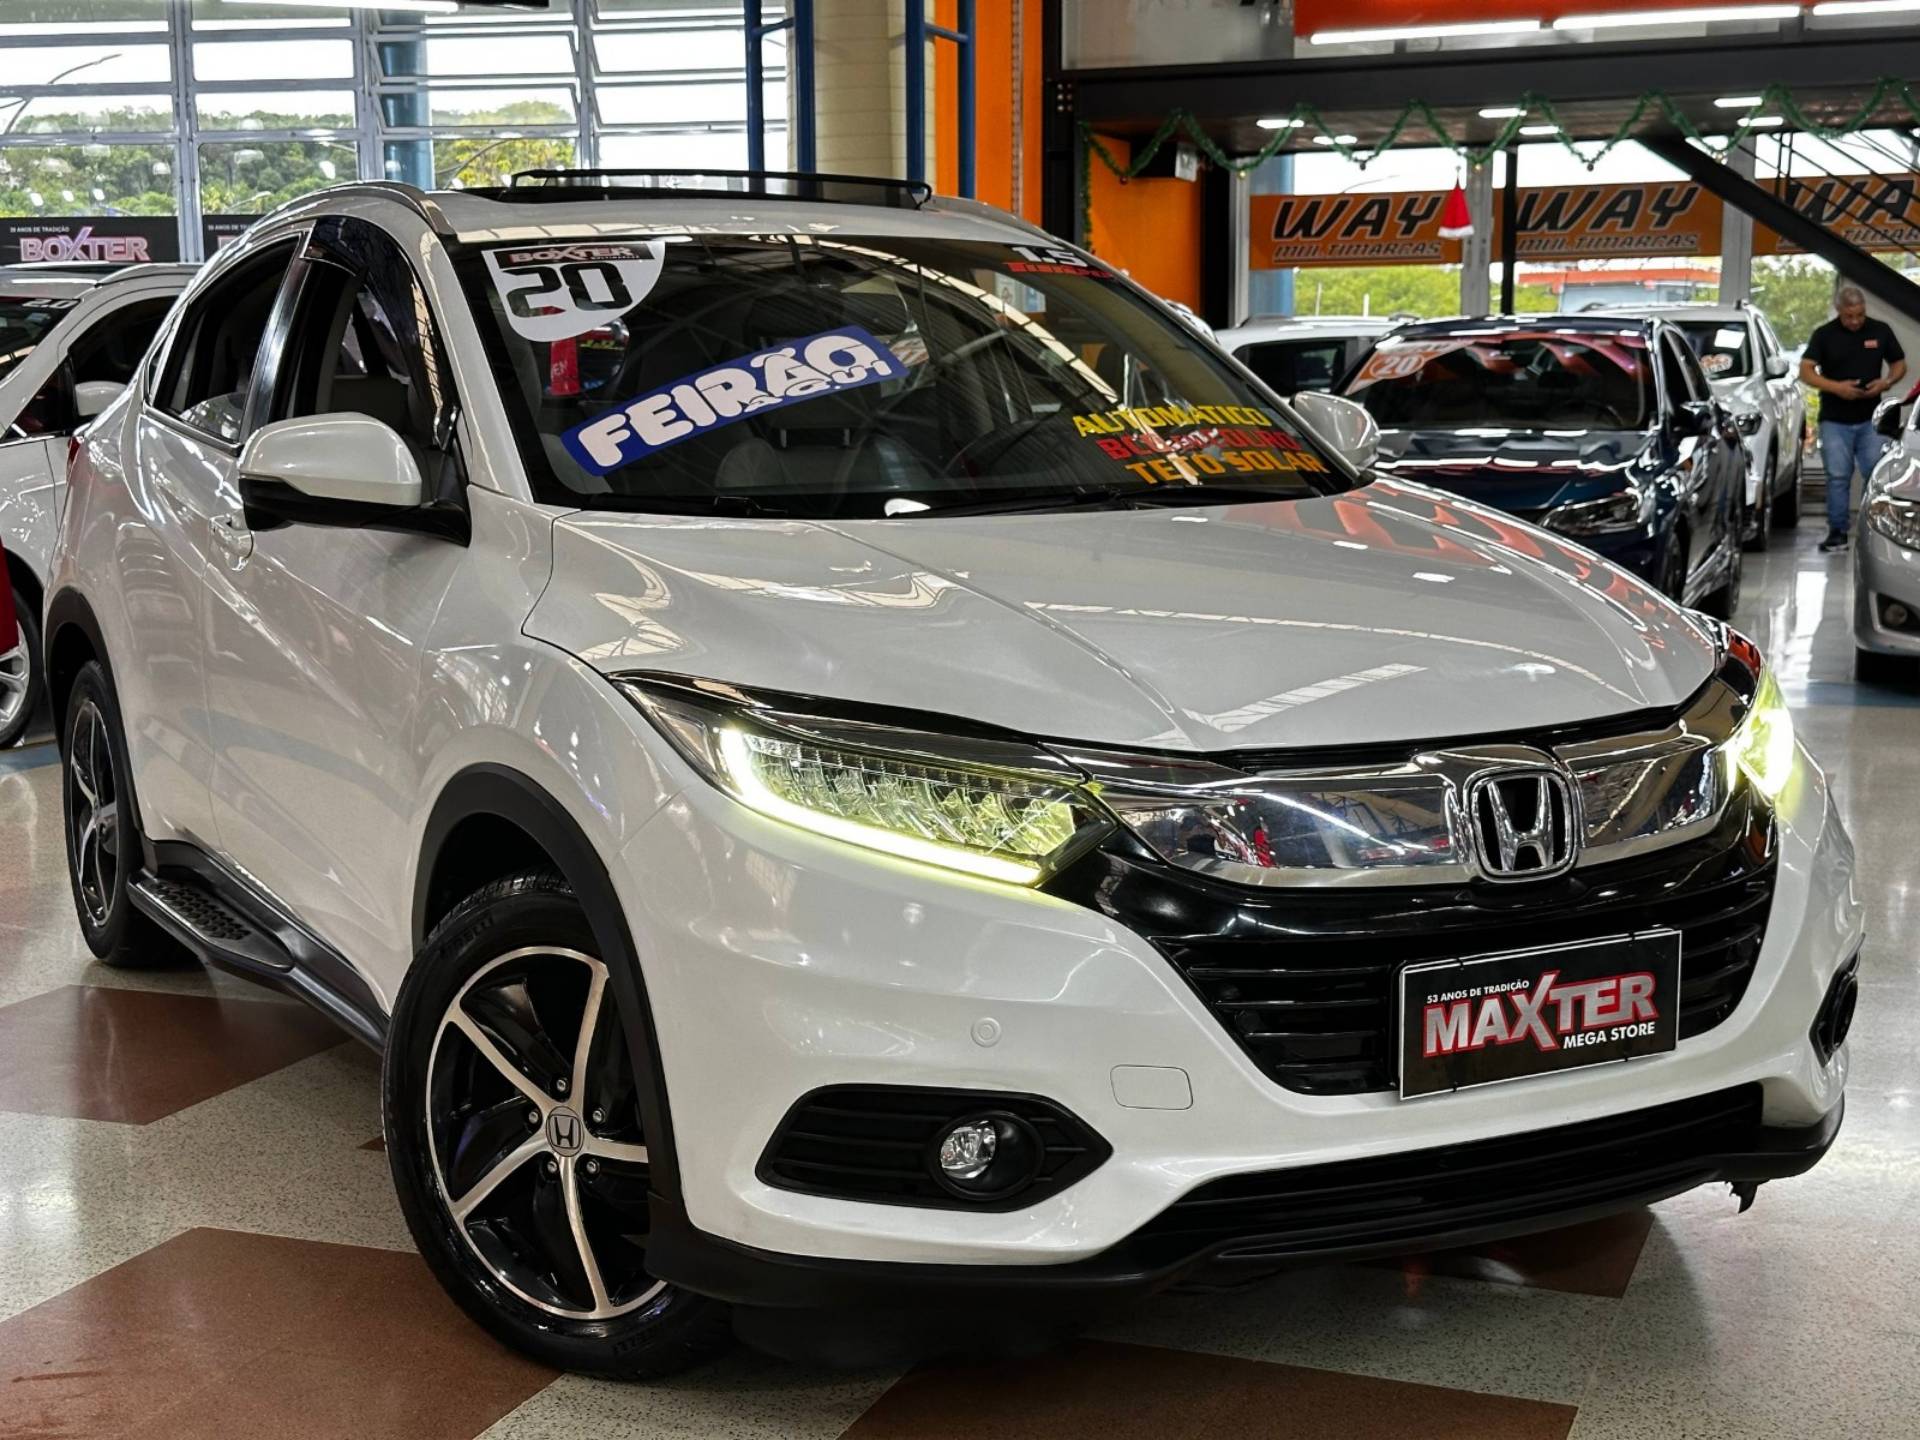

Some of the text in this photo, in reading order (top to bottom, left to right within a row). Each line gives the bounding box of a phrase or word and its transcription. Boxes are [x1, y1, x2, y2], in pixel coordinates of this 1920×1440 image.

[1273, 195, 1445, 240] WAY
[1516, 184, 1699, 233] WAY
[20, 226, 150, 262] BOXTER
[508, 245, 634, 263] BOXTER
[1011, 246, 1088, 267] 1.5
[22, 298, 80, 309] 2.0
[502, 262, 633, 318] 20
[578, 335, 888, 467] FEIRÃO
[1125, 450, 1331, 484] TETO SOLAR
[1427, 979, 1530, 1004] 53 ANOS DE TRADIÇÃO
[1423, 970, 1660, 1058] MAXTER
[1563, 1021, 1656, 1049] MEGA STORE
